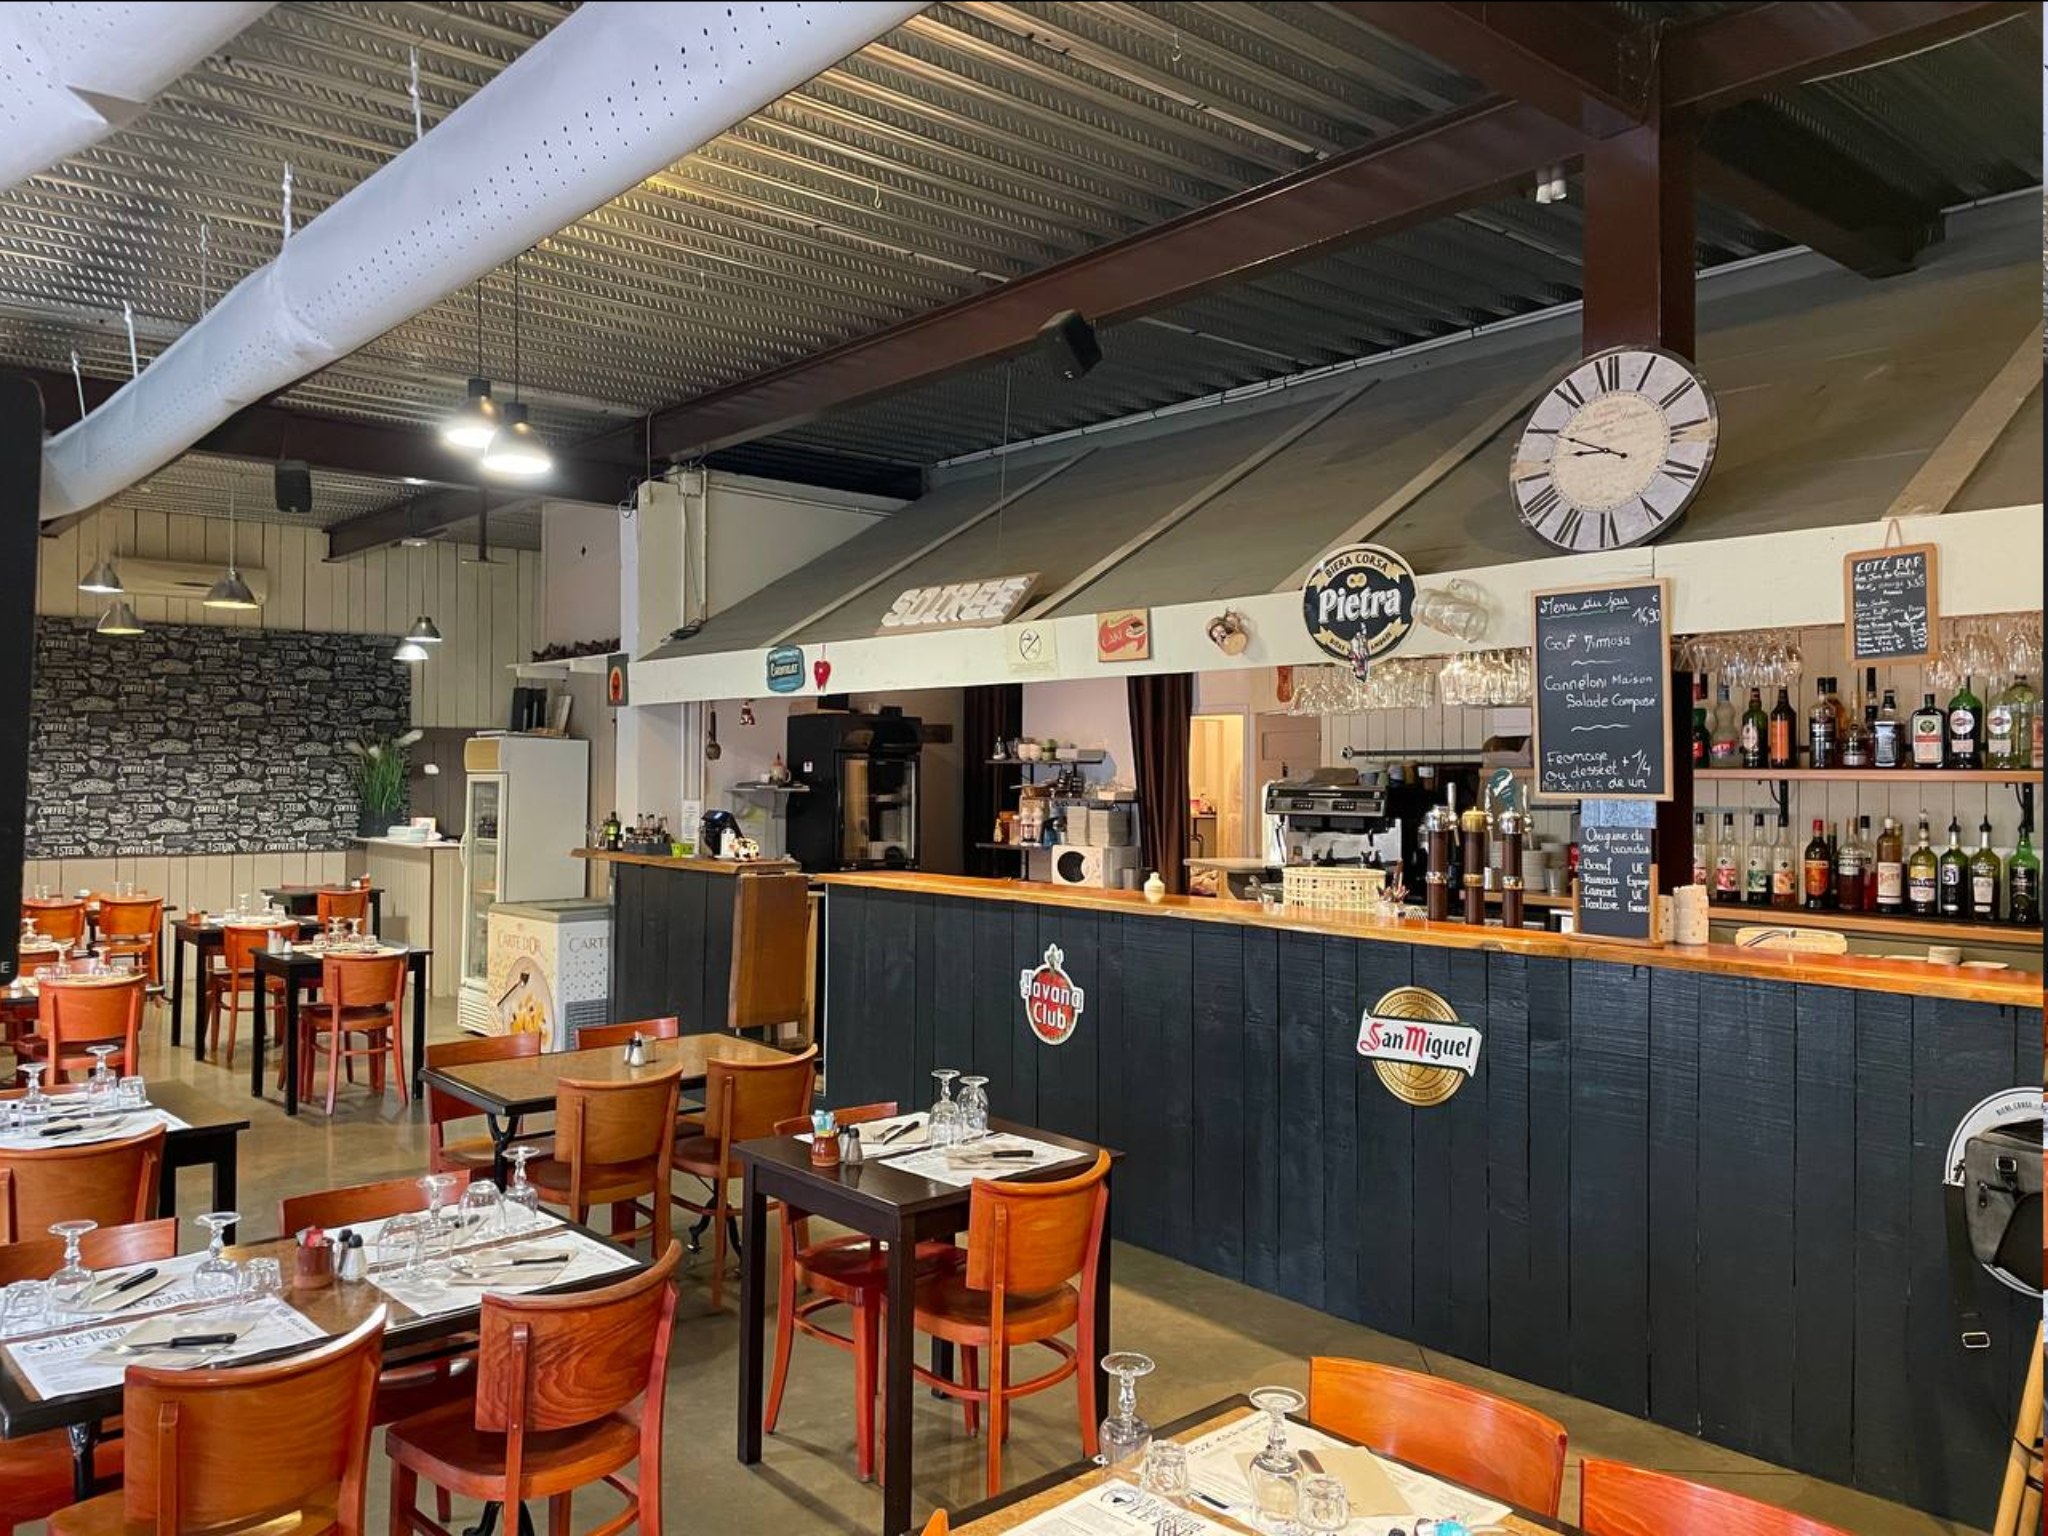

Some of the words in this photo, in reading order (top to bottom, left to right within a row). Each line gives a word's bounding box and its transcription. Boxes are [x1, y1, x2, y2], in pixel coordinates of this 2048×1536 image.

[1356, 554, 1388, 572] CORSA
[1318, 586, 1401, 624] Pietra
[1540, 596, 1578, 614] Menu
[1580, 597, 1603, 610] du
[1612, 673, 1653, 685] Maison
[1565, 692, 1608, 708] Salade
[1608, 777, 1624, 789] de
[1020, 971, 1083, 1011] Havana
[1033, 1002, 1066, 1030] Club
